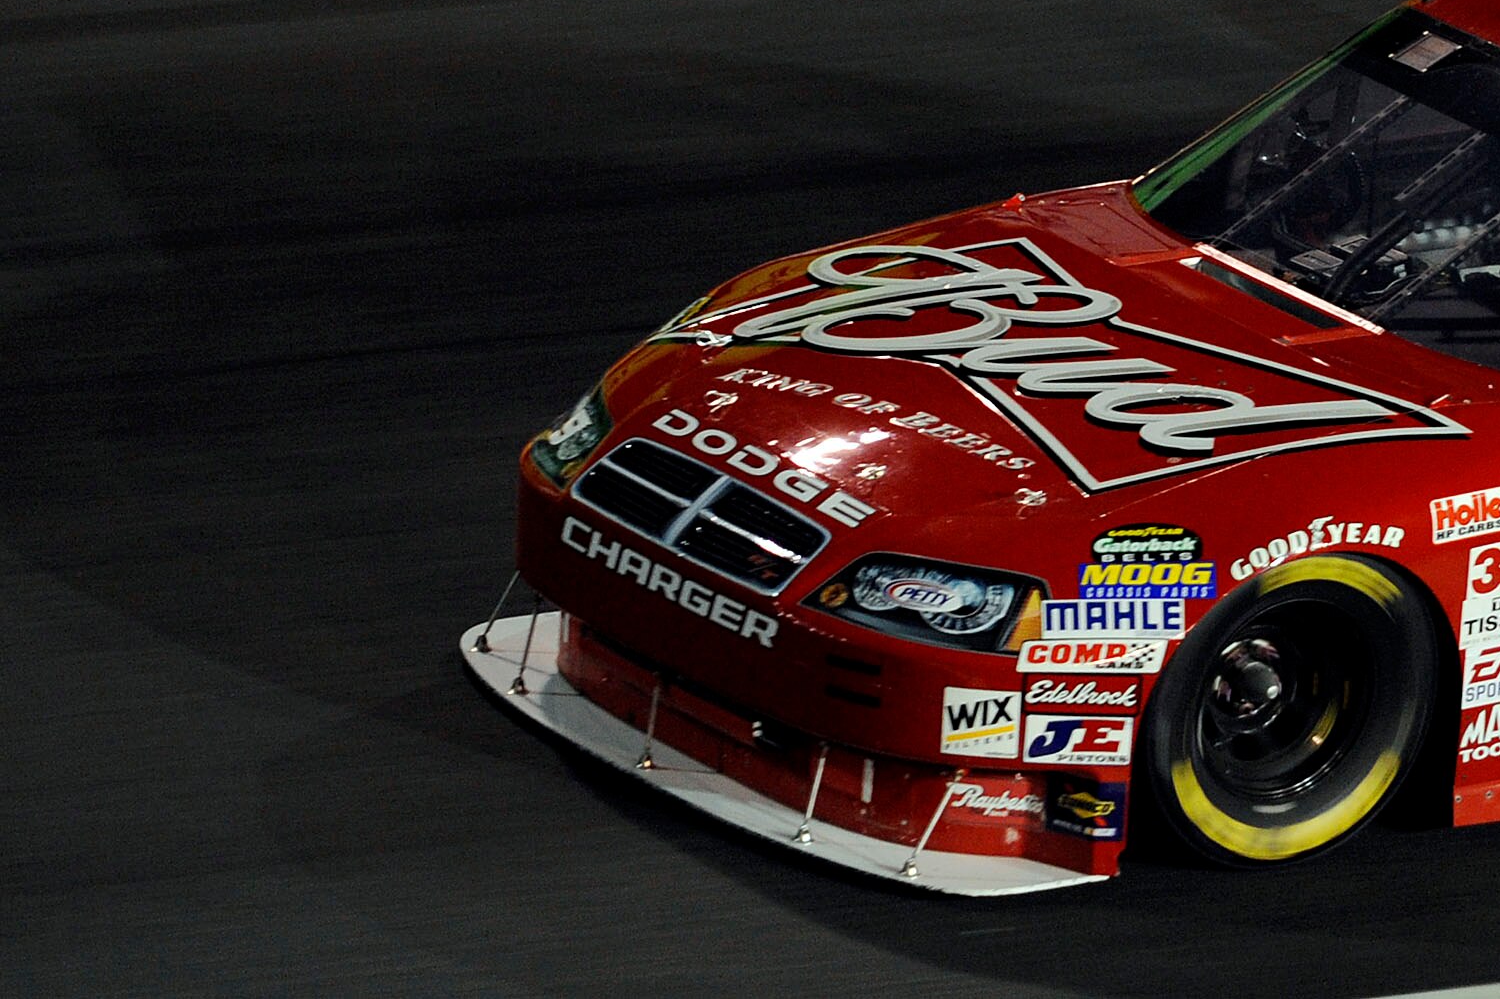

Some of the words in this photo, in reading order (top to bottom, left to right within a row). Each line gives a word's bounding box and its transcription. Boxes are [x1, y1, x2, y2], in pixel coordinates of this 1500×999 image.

[732, 245, 1401, 457] Bud
[715, 367, 835, 397] KING
[832, 392, 902, 415] OF
[652, 408, 877, 529] DODGE
[1093, 537, 1199, 554] Gatorback
[1100, 552, 1194, 563] BELTS
[1230, 515, 1406, 581] GOODYEAR
[560, 516, 780, 648] CHARGER
[1079, 562, 1215, 586] MOOG
[900, 586, 955, 606] PETTY
[1085, 586, 1153, 599] CHASSIS
[1160, 586, 1210, 599] PARTS
[1045, 601, 1182, 632] MAHLE
[1026, 643, 1128, 665] COMP
[1024, 679, 1138, 708] Edelbrock
[947, 696, 1016, 731] WIX
[1028, 719, 1126, 758] JE
